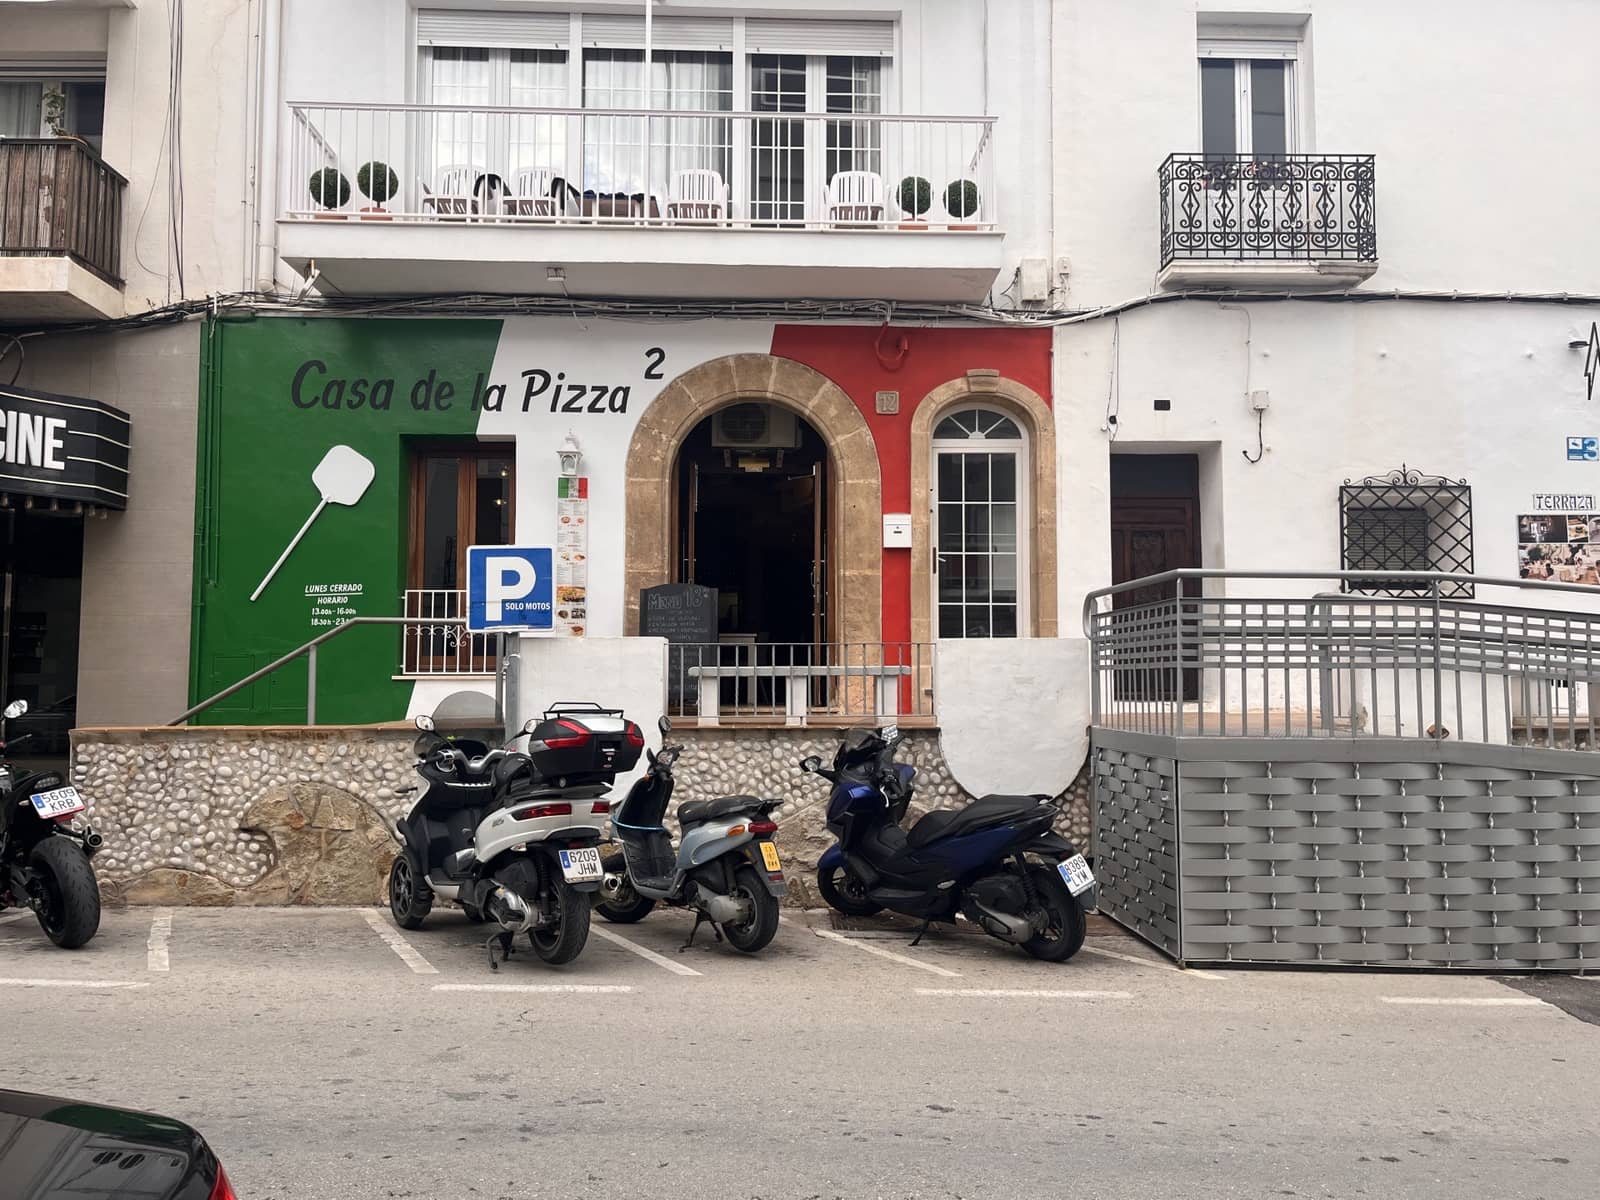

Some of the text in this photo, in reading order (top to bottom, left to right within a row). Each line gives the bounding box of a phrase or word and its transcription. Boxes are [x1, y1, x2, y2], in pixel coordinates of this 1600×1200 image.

[291, 347, 666, 414] Casa de la Pizza 2
[0, 409, 67, 470] INE
[1535, 495, 1593, 509] TERRAZA
[304, 584, 363, 593] LUNES CERRADO
[486, 556, 536, 621] P
[317, 596, 349, 605] HORARIO
[505, 602, 524, 610] SOLO
[525, 602, 551, 610] MOTOS
[42, 789, 75, 802] 5609
[49, 799, 75, 811] KRB
[569, 850, 598, 863] 6209
[578, 863, 598, 875] JHM
